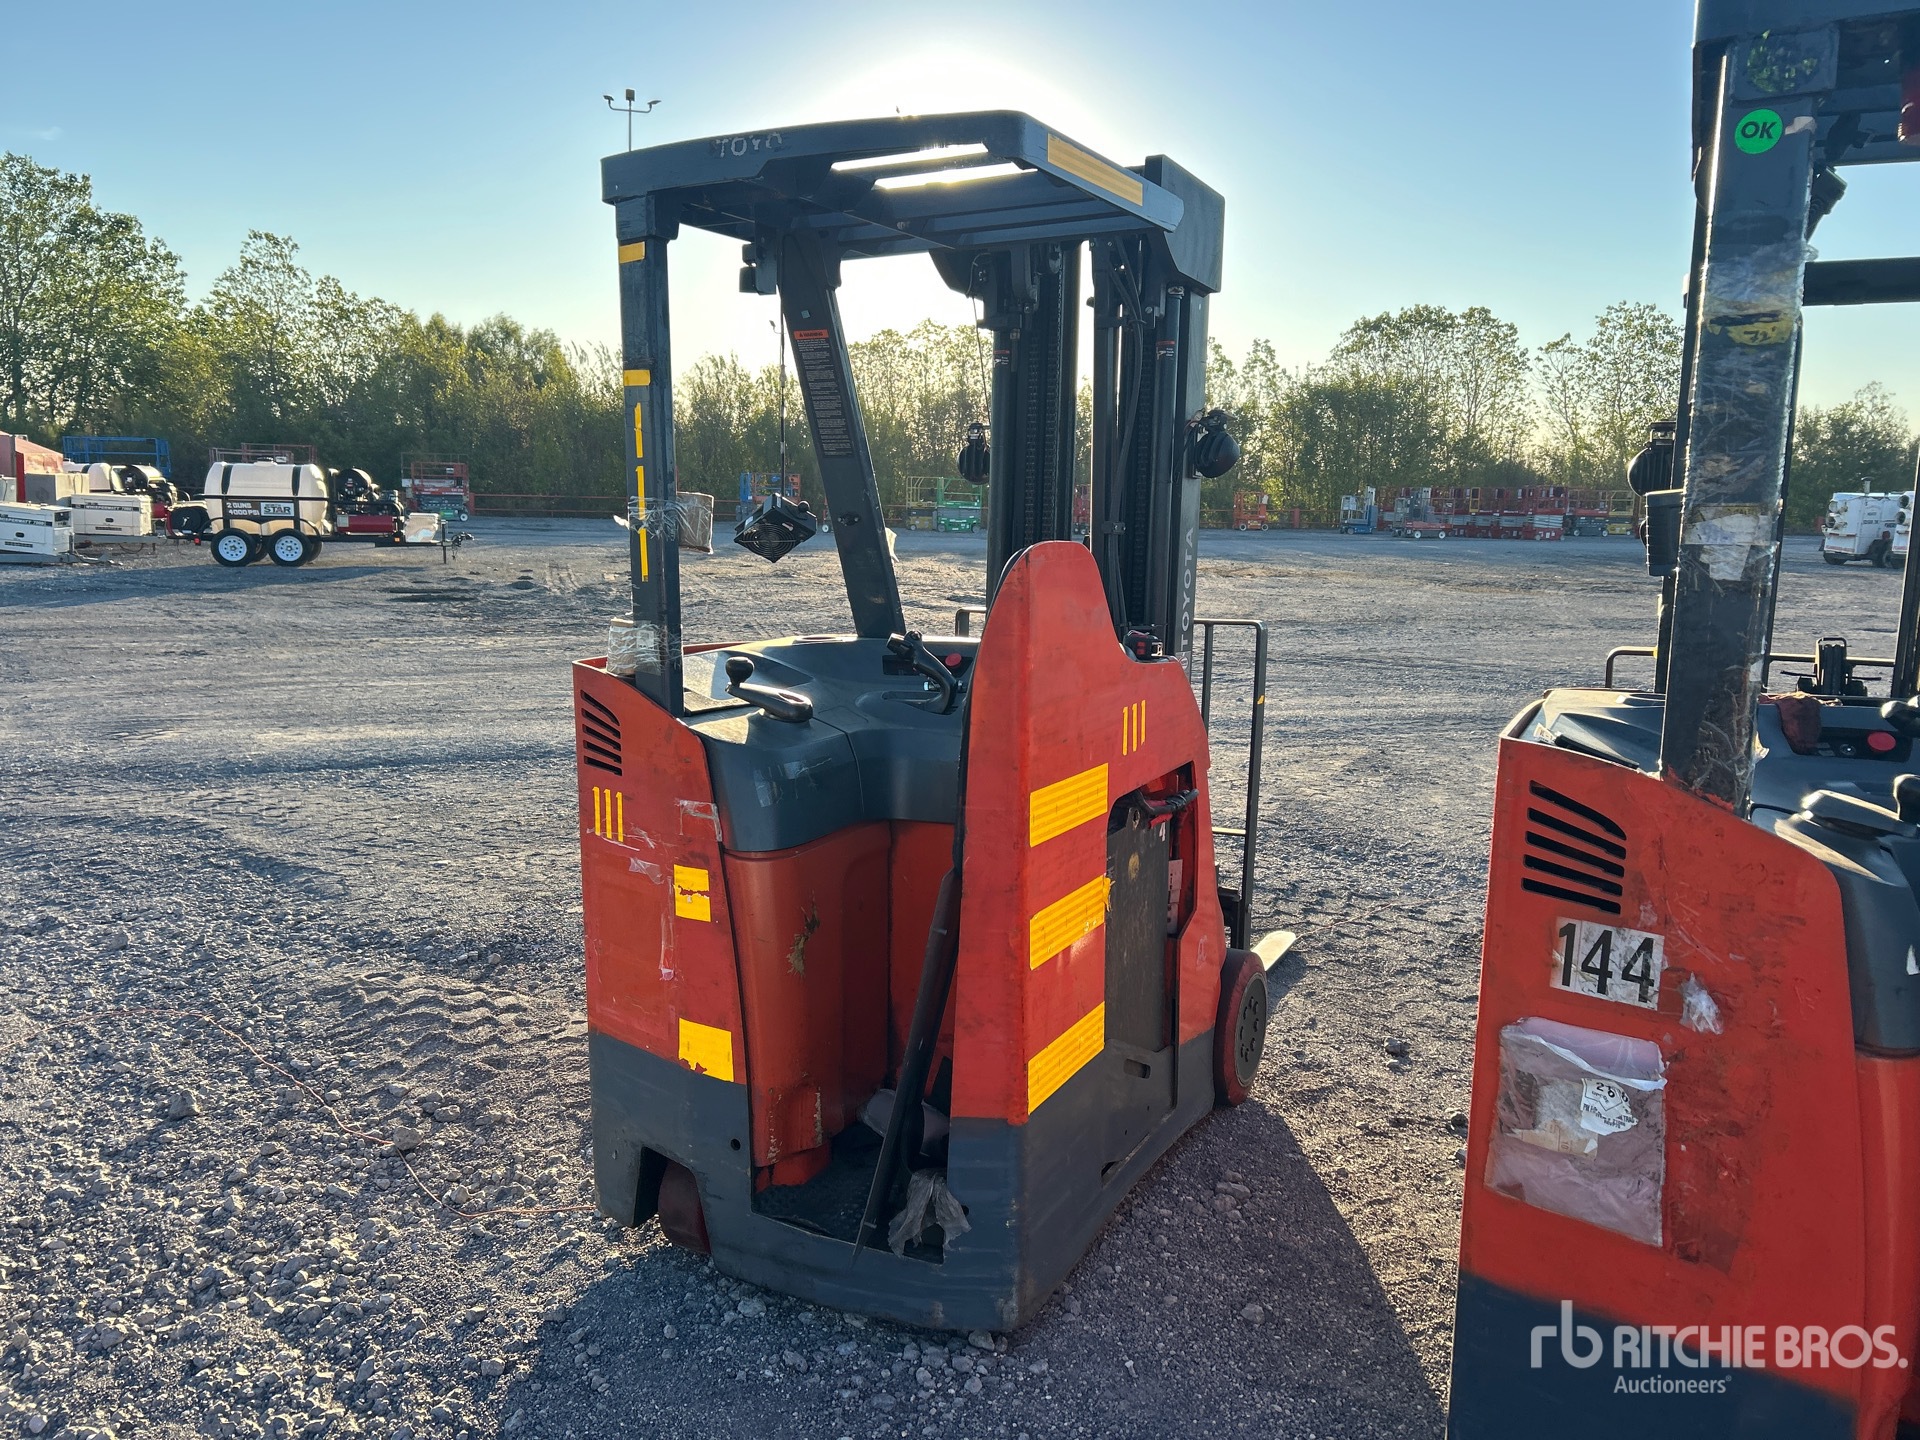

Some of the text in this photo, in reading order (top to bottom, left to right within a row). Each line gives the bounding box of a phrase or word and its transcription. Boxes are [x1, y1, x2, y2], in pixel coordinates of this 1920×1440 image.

[1741, 121, 1777, 139] OK
[1181, 527, 1194, 652] TOYOTA
[1558, 922, 1656, 1004] 144
